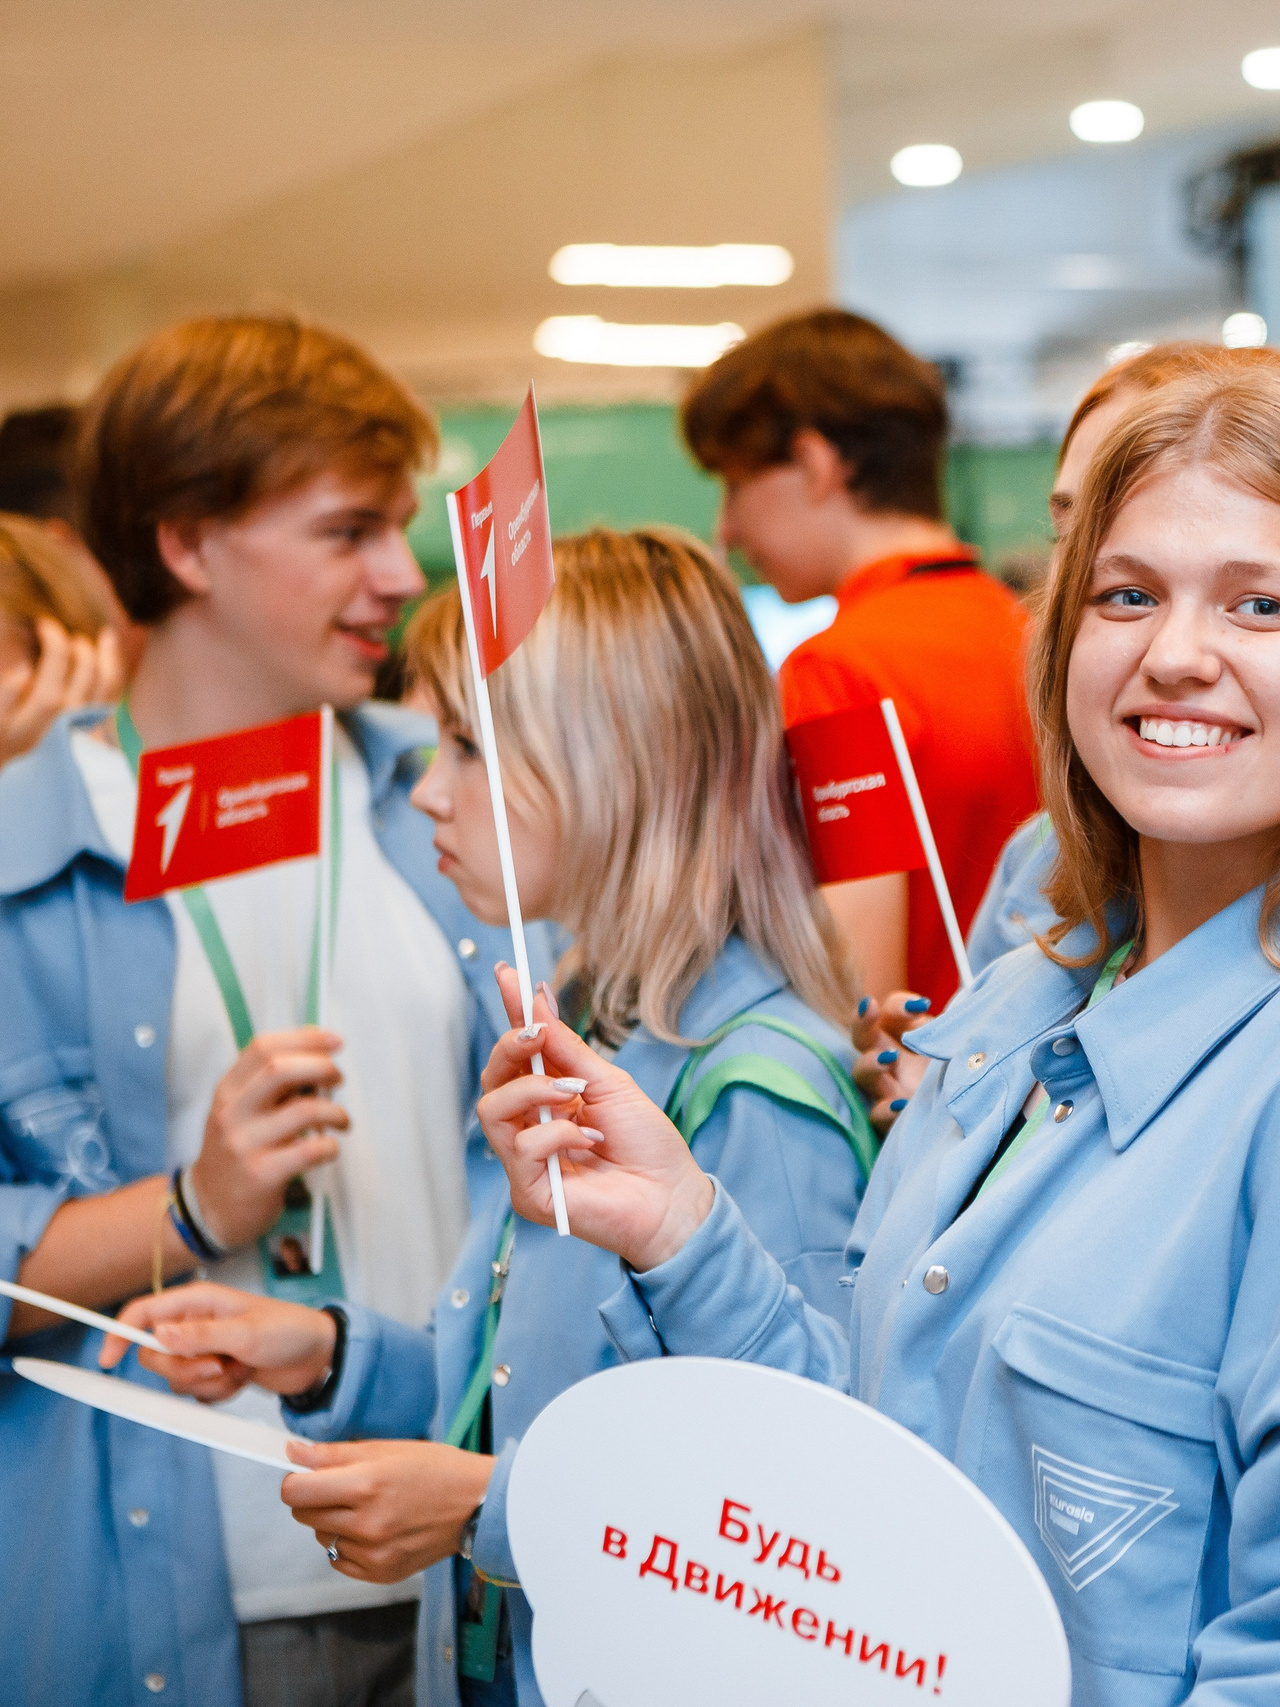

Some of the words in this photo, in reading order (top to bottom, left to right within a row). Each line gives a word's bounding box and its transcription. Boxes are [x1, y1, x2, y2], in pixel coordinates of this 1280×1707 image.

[718, 1497, 842, 1584] Будь
[601, 1524, 628, 1560] в
[638, 1534, 948, 1695] Движении!
